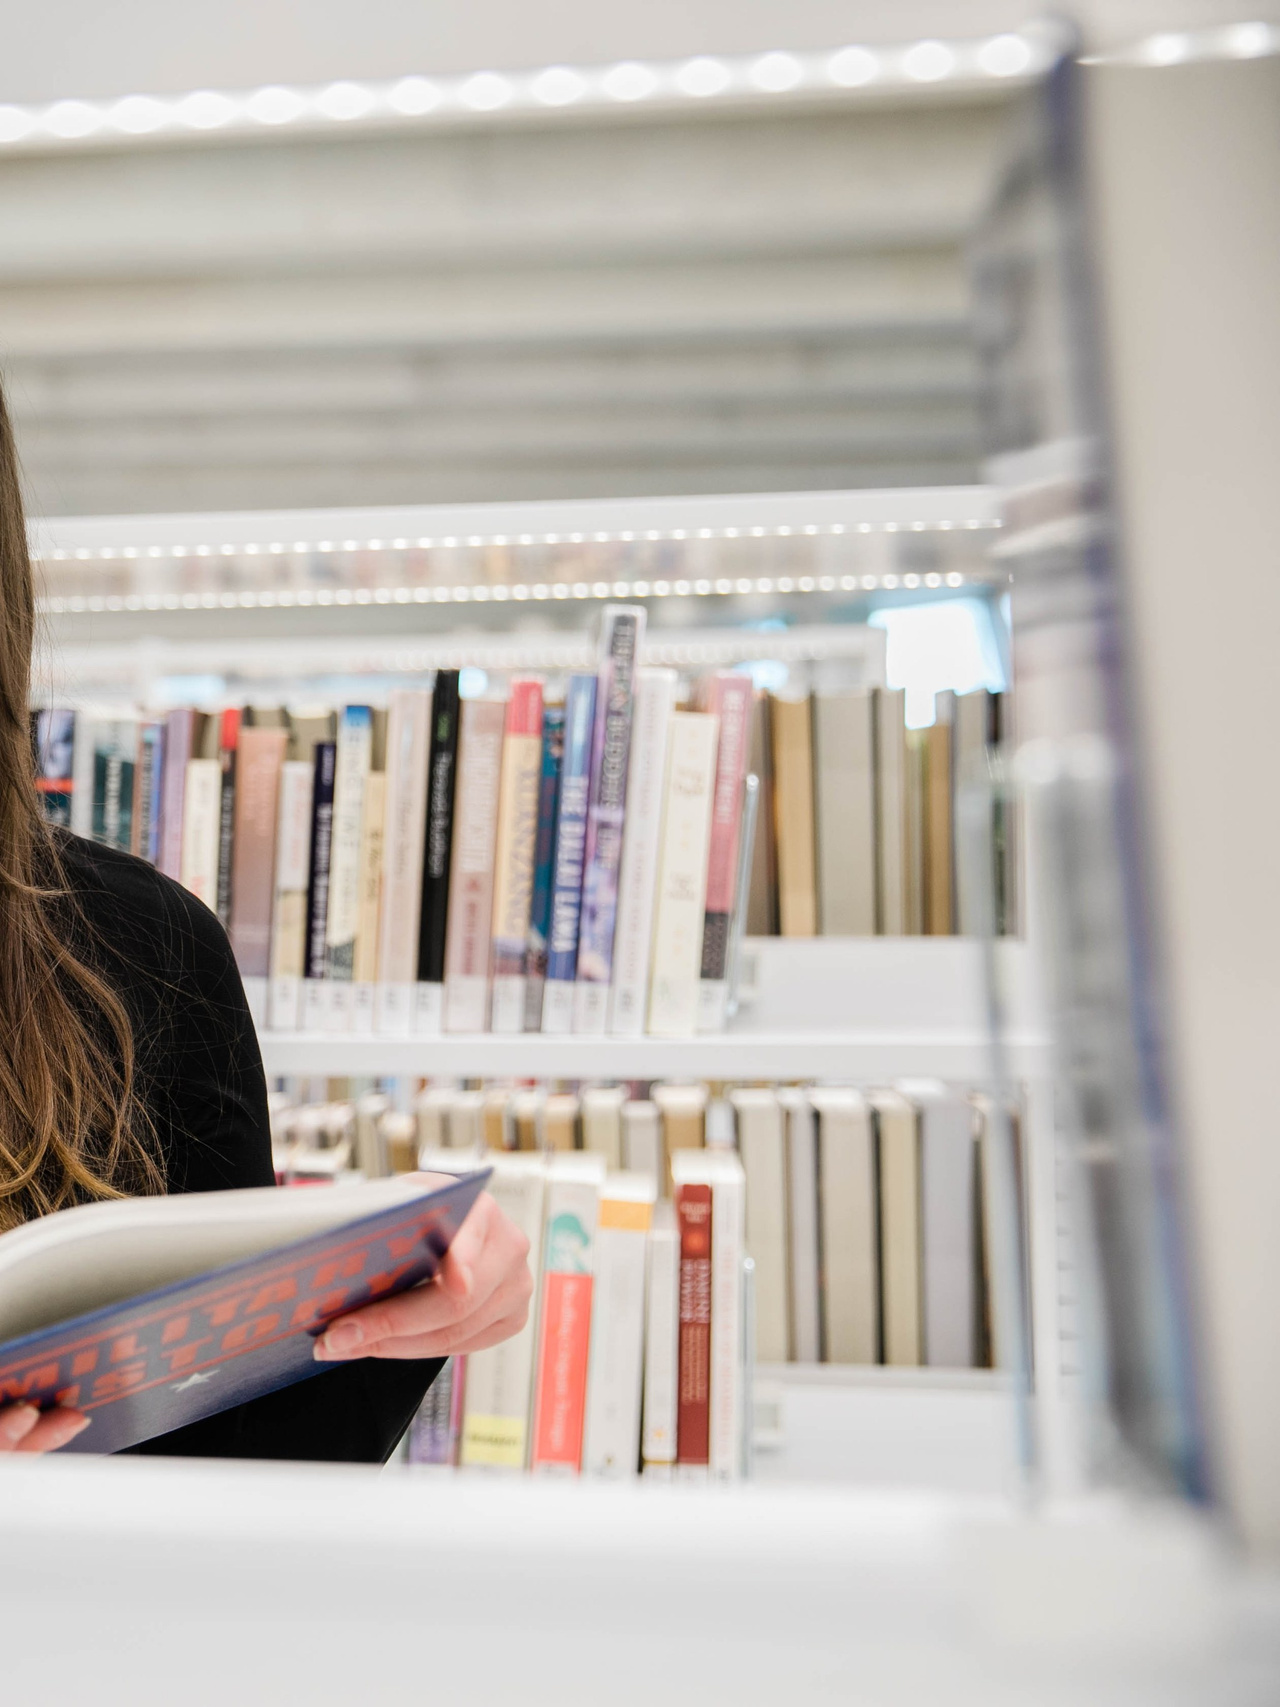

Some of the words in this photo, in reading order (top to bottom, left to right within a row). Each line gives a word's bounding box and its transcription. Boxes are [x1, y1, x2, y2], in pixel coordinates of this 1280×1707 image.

[561, 775, 589, 816] THE
[557, 821, 587, 887] DALAI
[551, 892, 580, 953] LAMA
[26, 1258, 418, 1409] ISTORY
